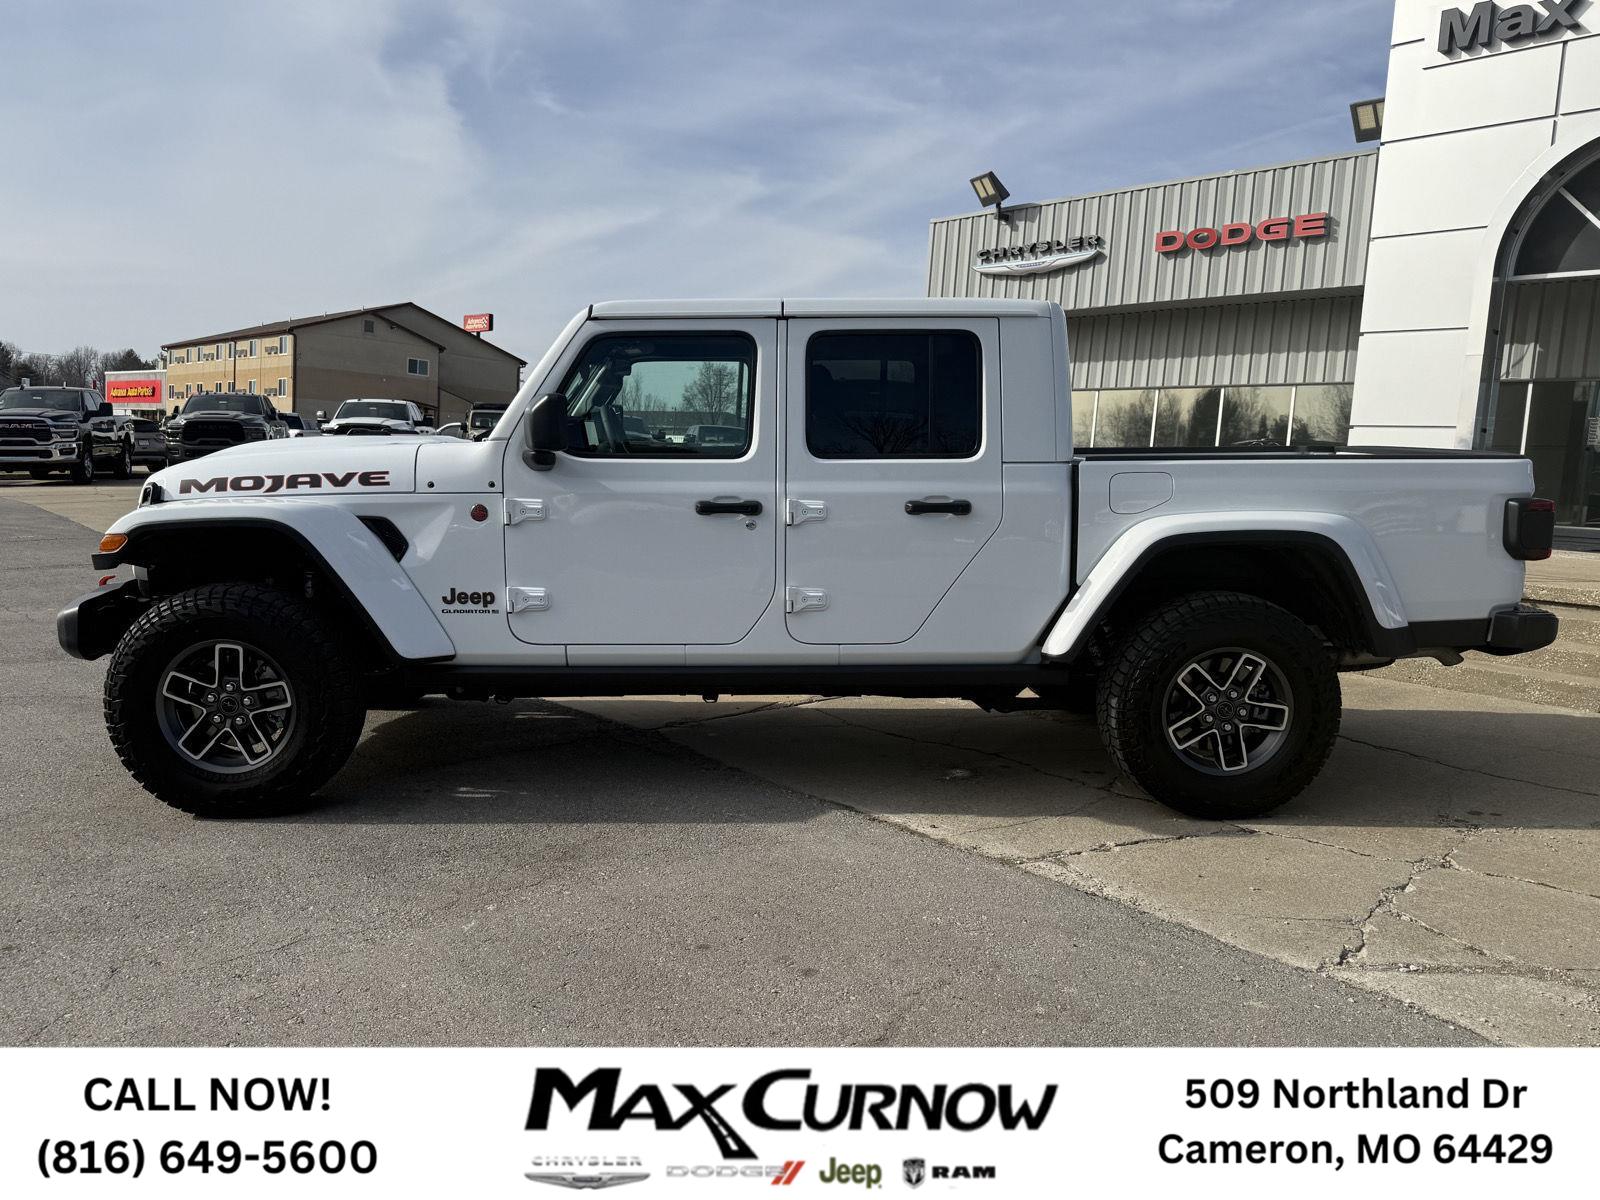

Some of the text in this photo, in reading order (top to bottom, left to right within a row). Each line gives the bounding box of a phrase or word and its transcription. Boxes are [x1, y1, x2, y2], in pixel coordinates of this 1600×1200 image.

[1437, 0, 1581, 55] Max
[1155, 211, 1328, 253] DODGE
[976, 234, 1101, 262] CHRYSLER
[179, 470, 391, 494] MOJAVE
[441, 587, 496, 608] Jeep
